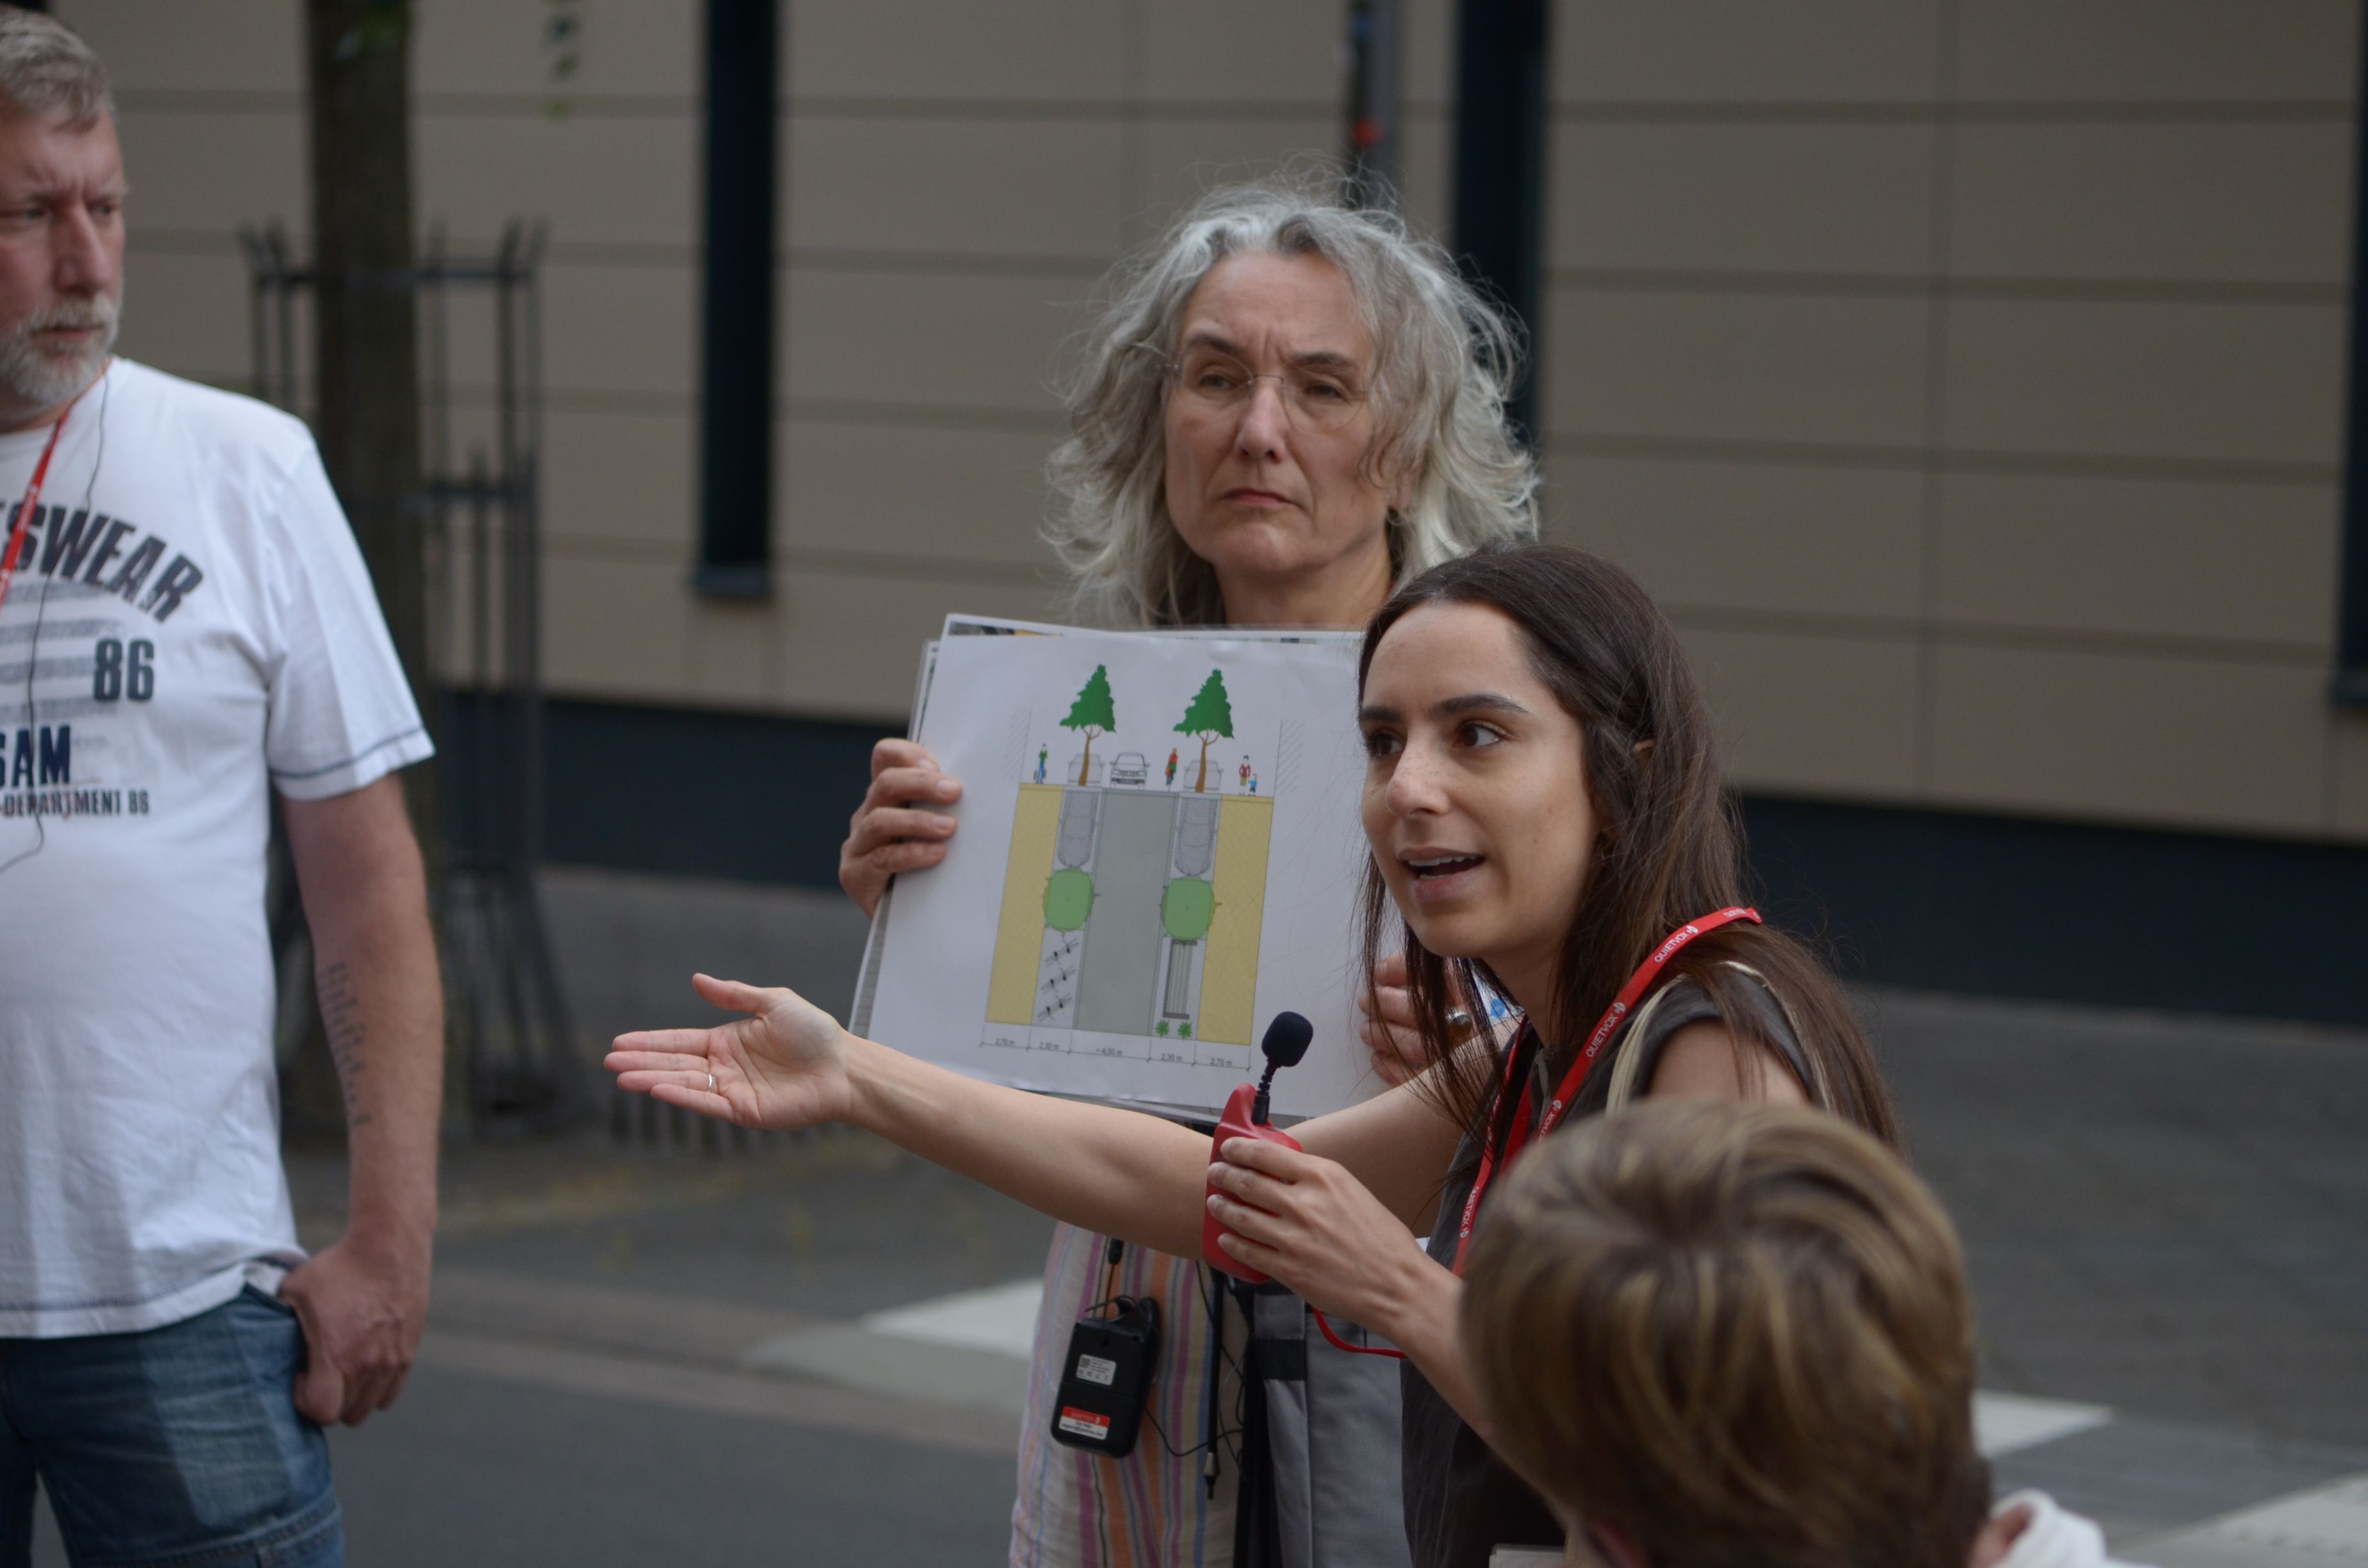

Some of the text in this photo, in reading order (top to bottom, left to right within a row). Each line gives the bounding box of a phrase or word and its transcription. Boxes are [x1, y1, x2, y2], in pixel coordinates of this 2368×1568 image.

[0, 501, 203, 623] SWEAR
[94, 639, 154, 702] 86
[1654, 932, 1689, 962] QUIETVOX
[1586, 1013, 1618, 1057] QUIETVOX
[1462, 1186, 1479, 1226] QUIETVOX
